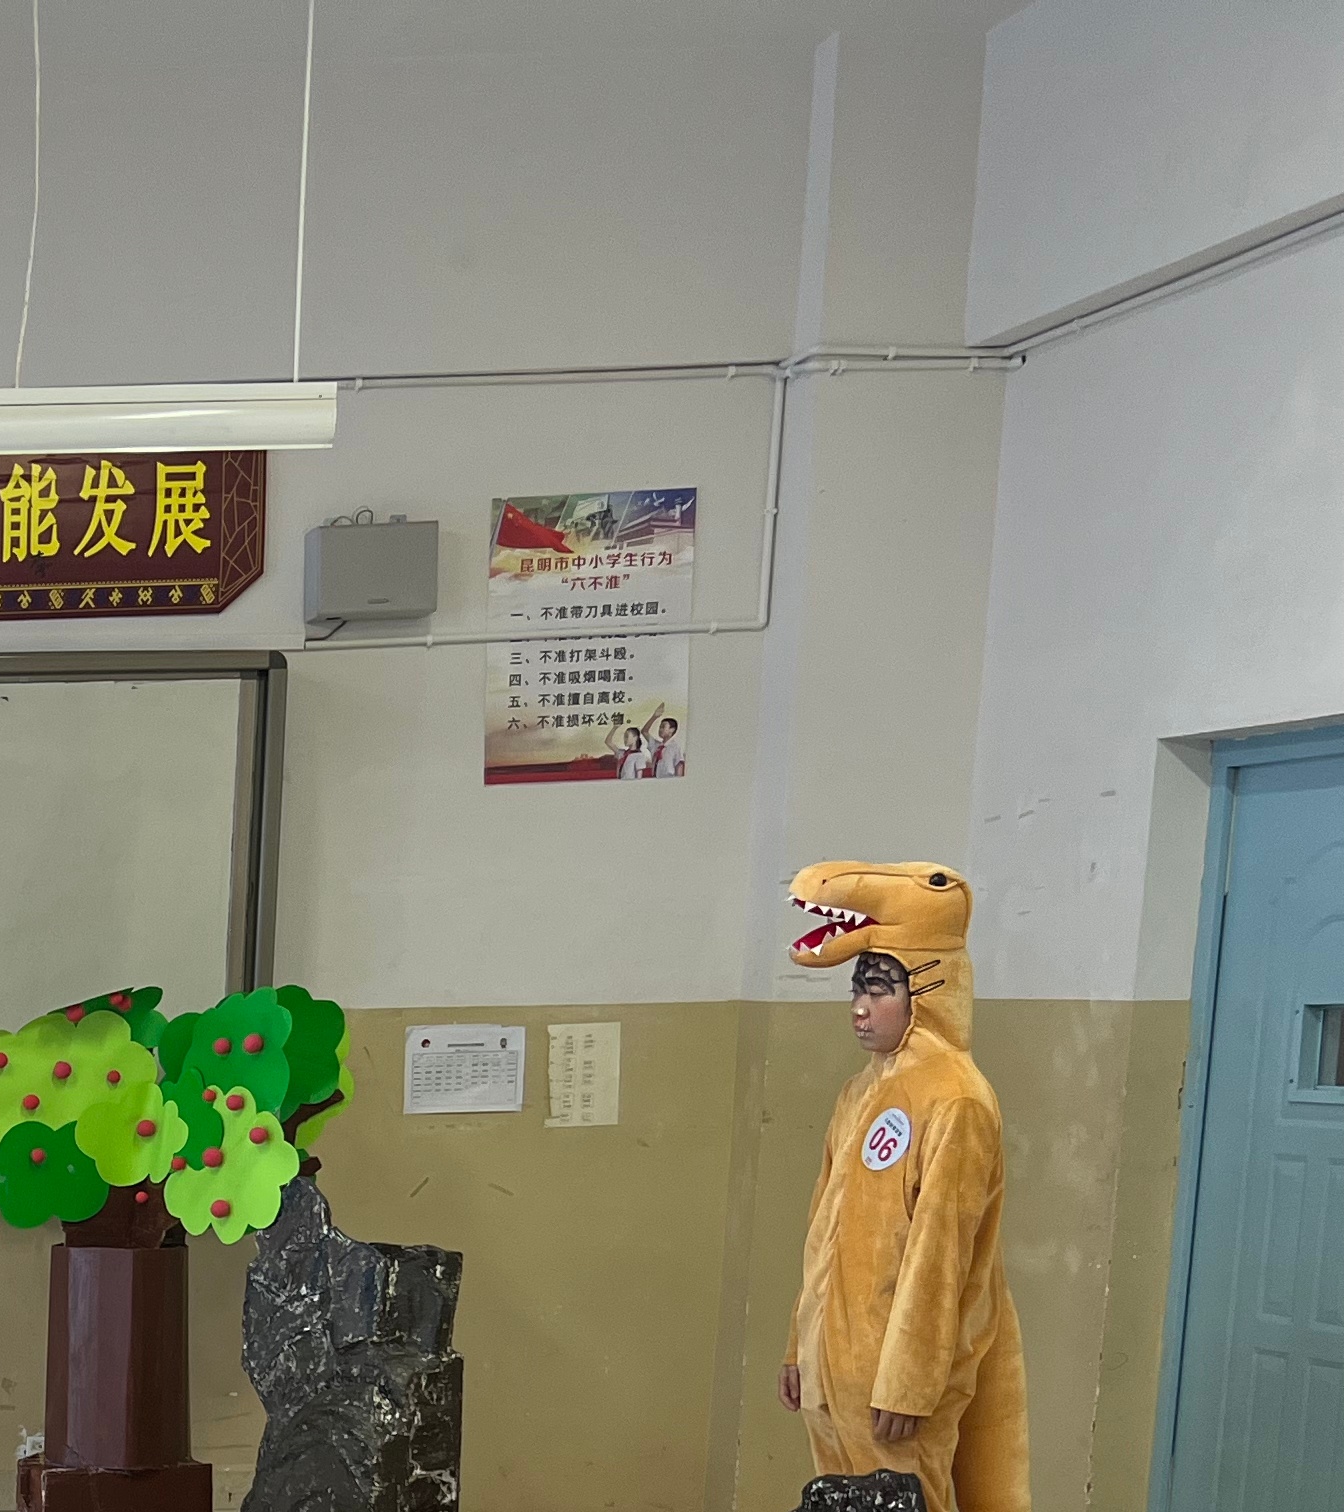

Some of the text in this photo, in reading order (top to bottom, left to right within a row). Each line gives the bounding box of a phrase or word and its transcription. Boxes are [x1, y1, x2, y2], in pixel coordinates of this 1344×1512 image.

[0, 461, 212, 563] 能发展
[520, 550, 673, 574] 昆明市中小学生行为
[561, 574, 631, 591] “六不准”
[869, 1126, 898, 1162] 06
